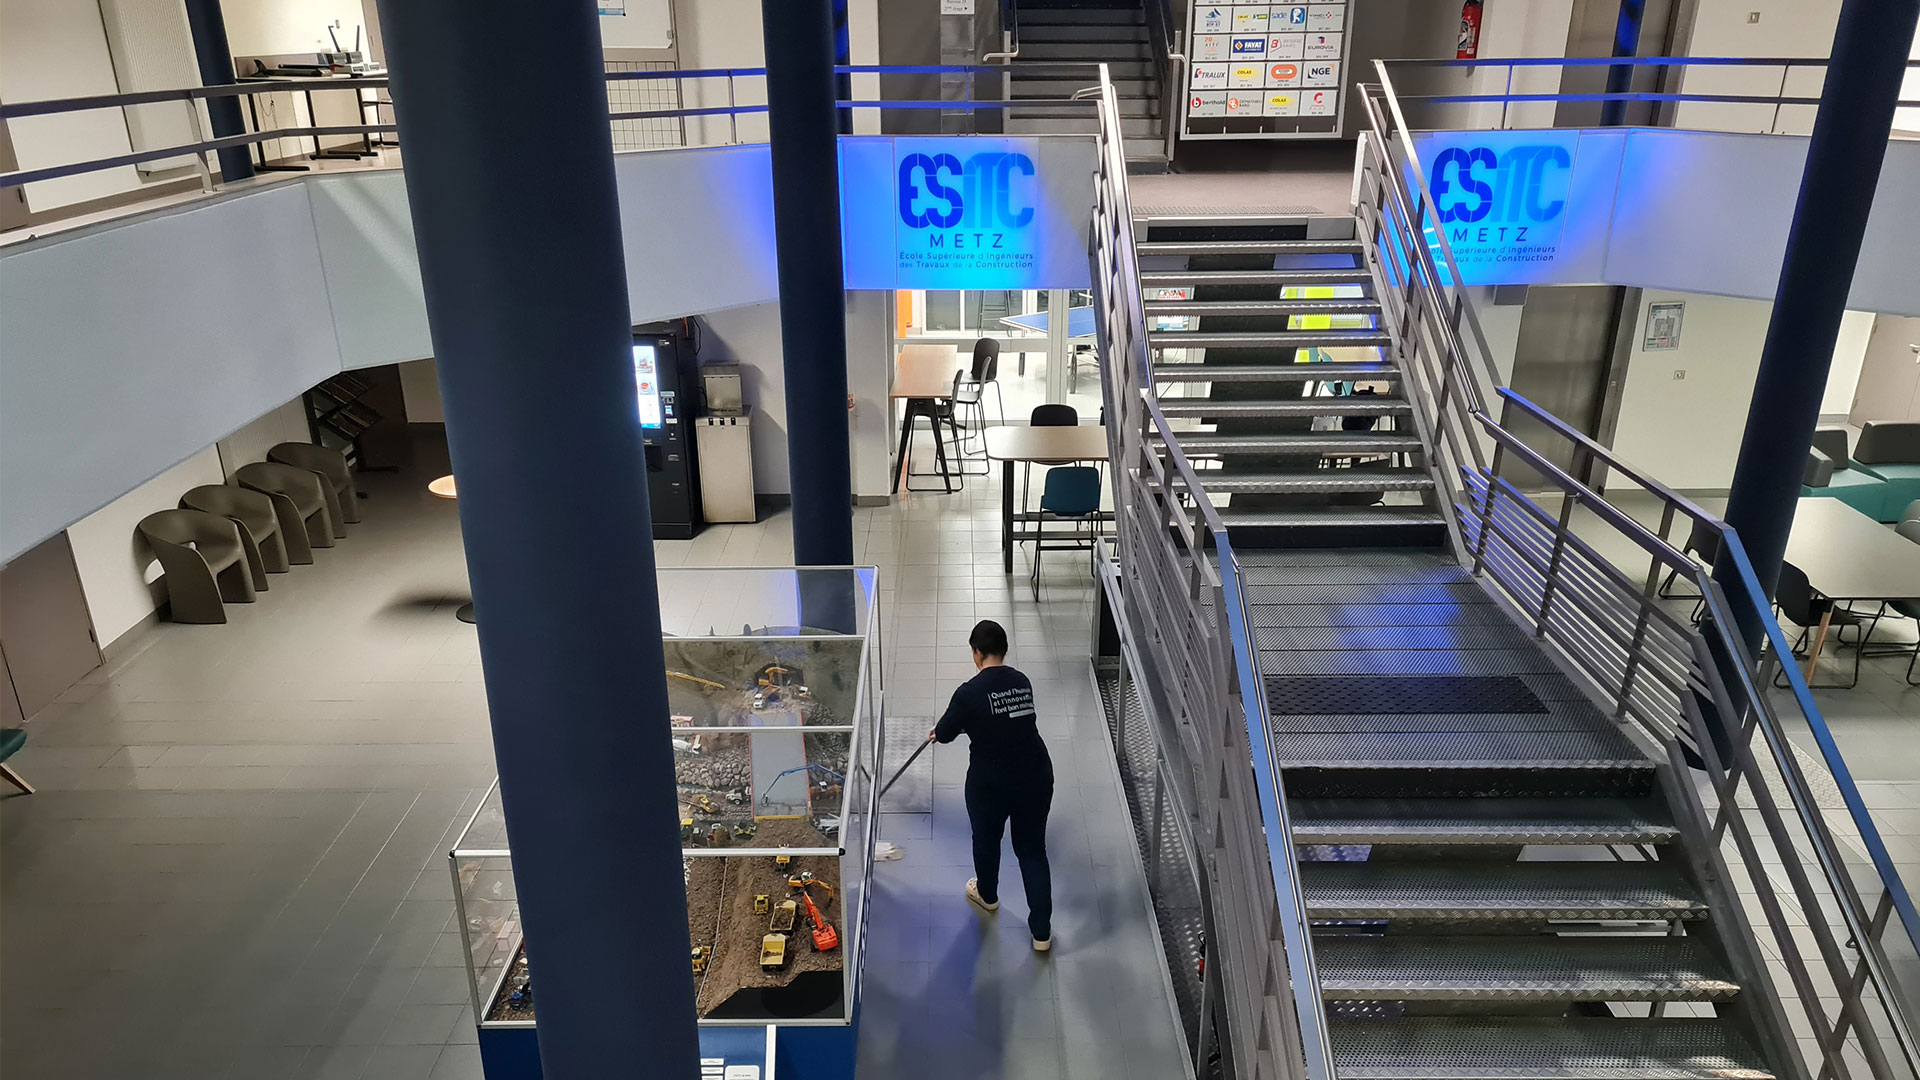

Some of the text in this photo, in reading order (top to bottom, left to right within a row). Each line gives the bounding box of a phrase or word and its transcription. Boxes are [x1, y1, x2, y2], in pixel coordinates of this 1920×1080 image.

[1244, 41, 1263, 49] FAYAT
[1311, 67, 1331, 76] NGE
[1429, 146, 1571, 223] ESITC
[899, 152, 1035, 228] ESITC
[1452, 227, 1529, 243] METZ
[930, 233, 1003, 248] METZ
[899, 251, 924, 260] École
[927, 252, 975, 261] Supérieure
[1496, 255, 1554, 263] Construction
[975, 260, 1033, 268] Construction
[991, 688, 1012, 699] Quand
[995, 706, 1008, 714] font
